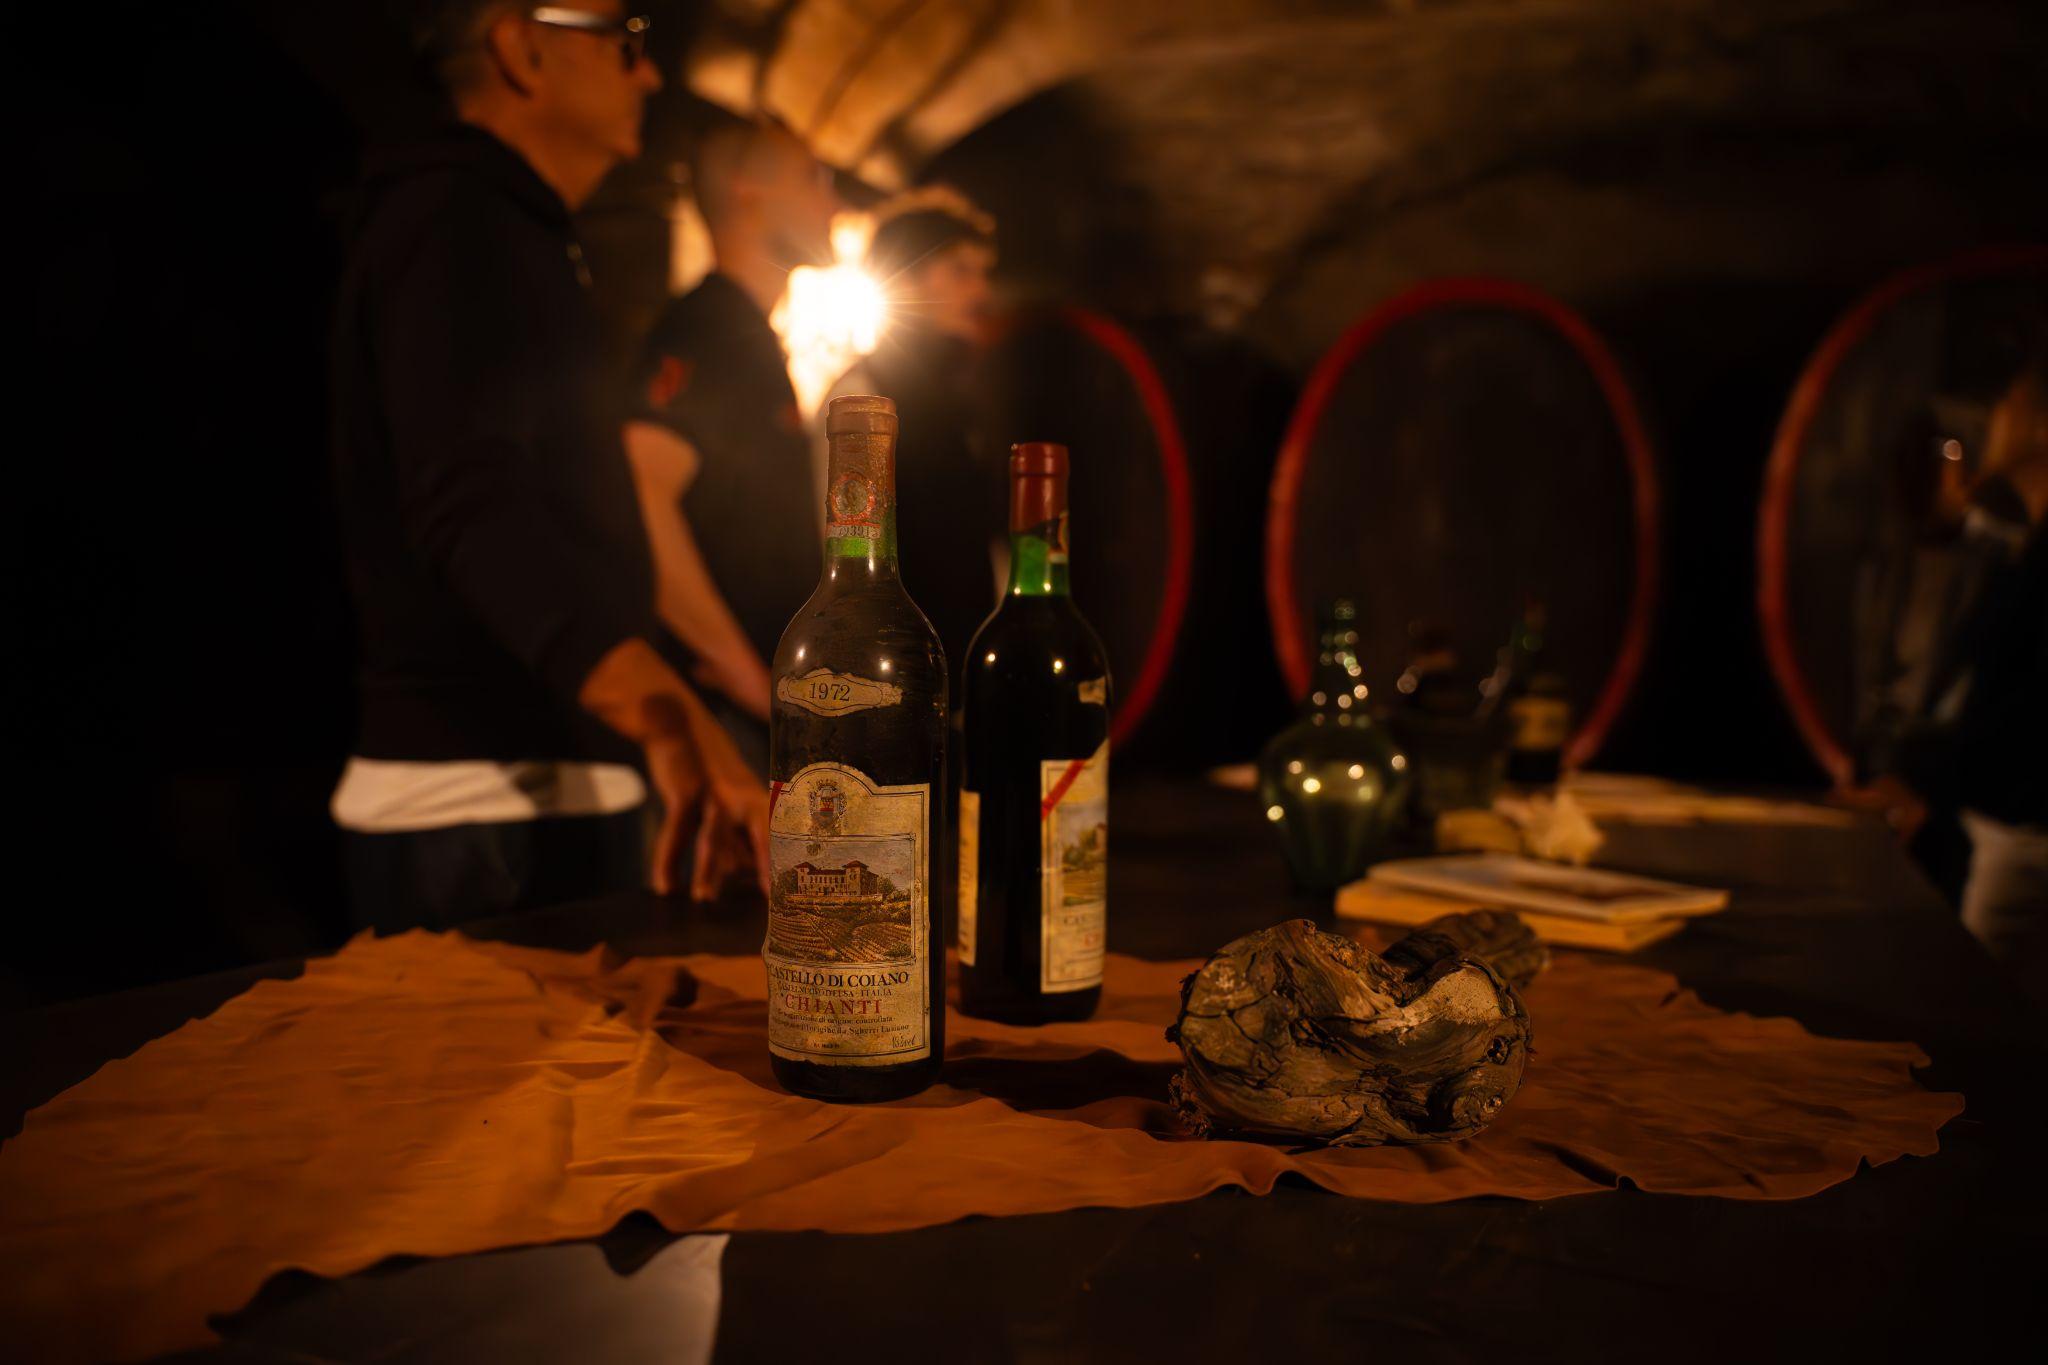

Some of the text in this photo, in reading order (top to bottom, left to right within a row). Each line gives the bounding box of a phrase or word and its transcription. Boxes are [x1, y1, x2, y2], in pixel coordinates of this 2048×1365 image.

[809, 683, 850, 702] 1972
[770, 965, 909, 988] CASTELLO DI COIANO
[860, 988, 893, 998] ITALIA
[785, 993, 882, 1015] CHIANTI
